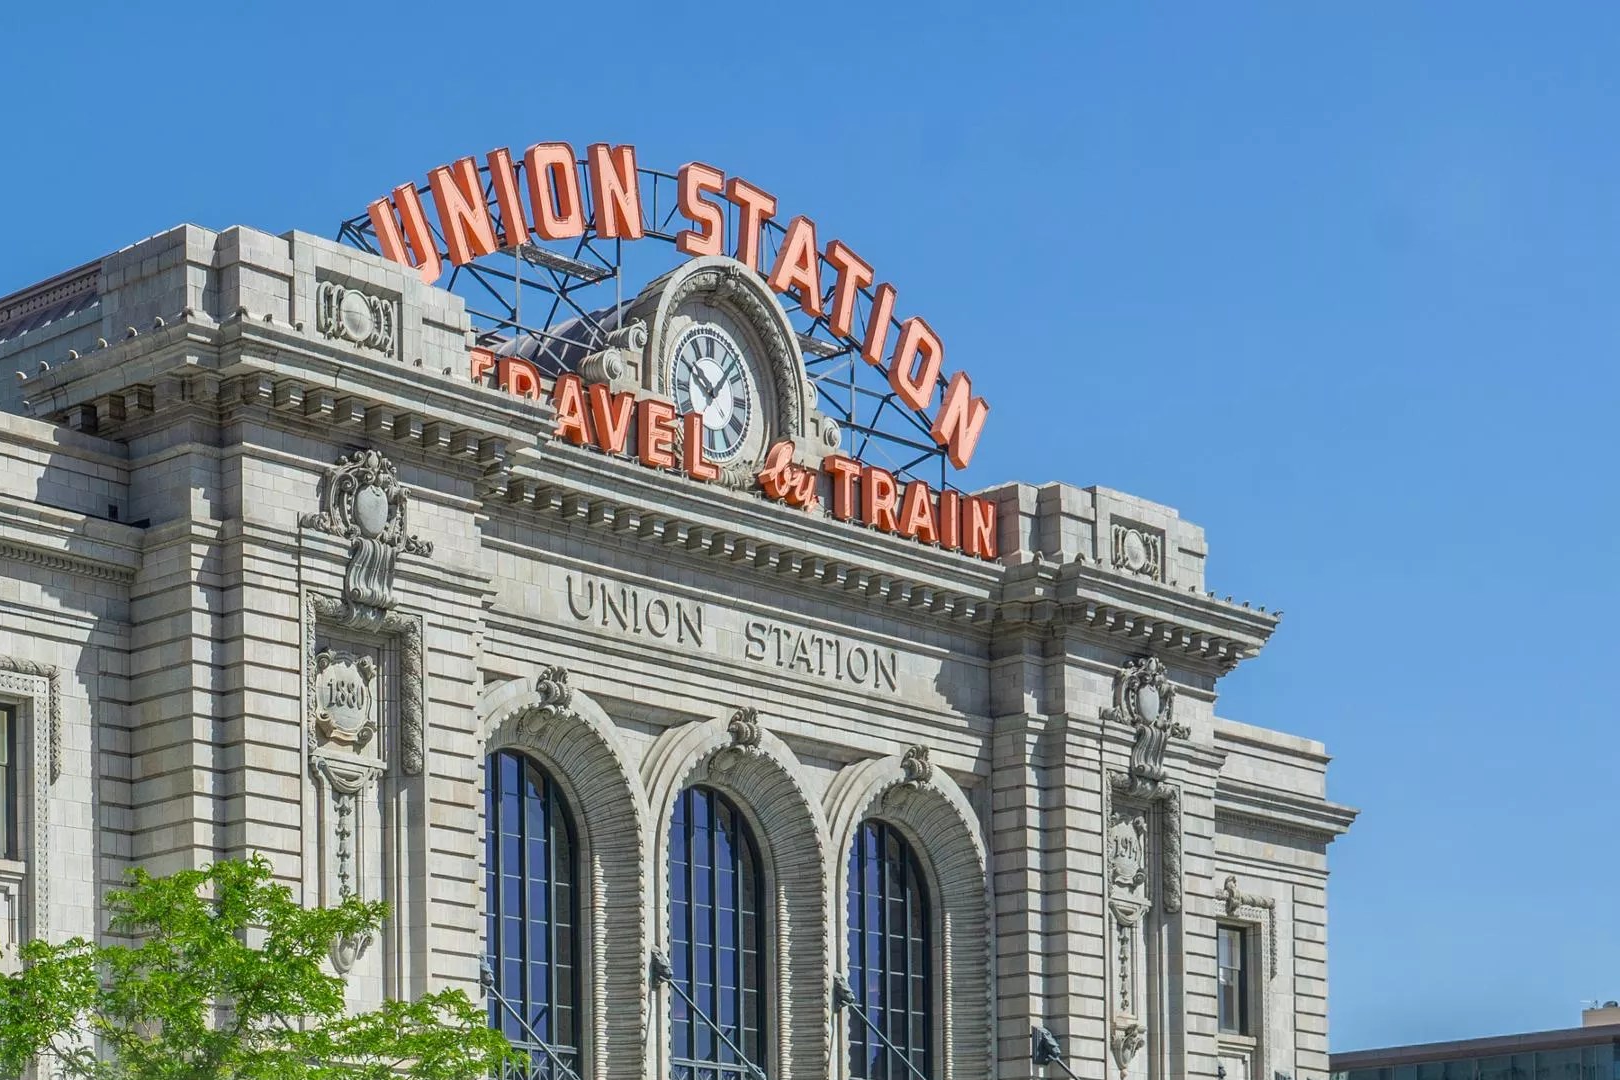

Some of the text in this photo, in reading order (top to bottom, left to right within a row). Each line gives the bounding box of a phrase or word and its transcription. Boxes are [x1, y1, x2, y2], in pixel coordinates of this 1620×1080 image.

[367, 141, 990, 470] UNION STATION
[758, 439, 819, 513] by
[824, 454, 998, 561] TRAIN
[566, 575, 900, 693] UNION STATION
[327, 679, 364, 710] 1880
[1113, 836, 1138, 862] 1914
